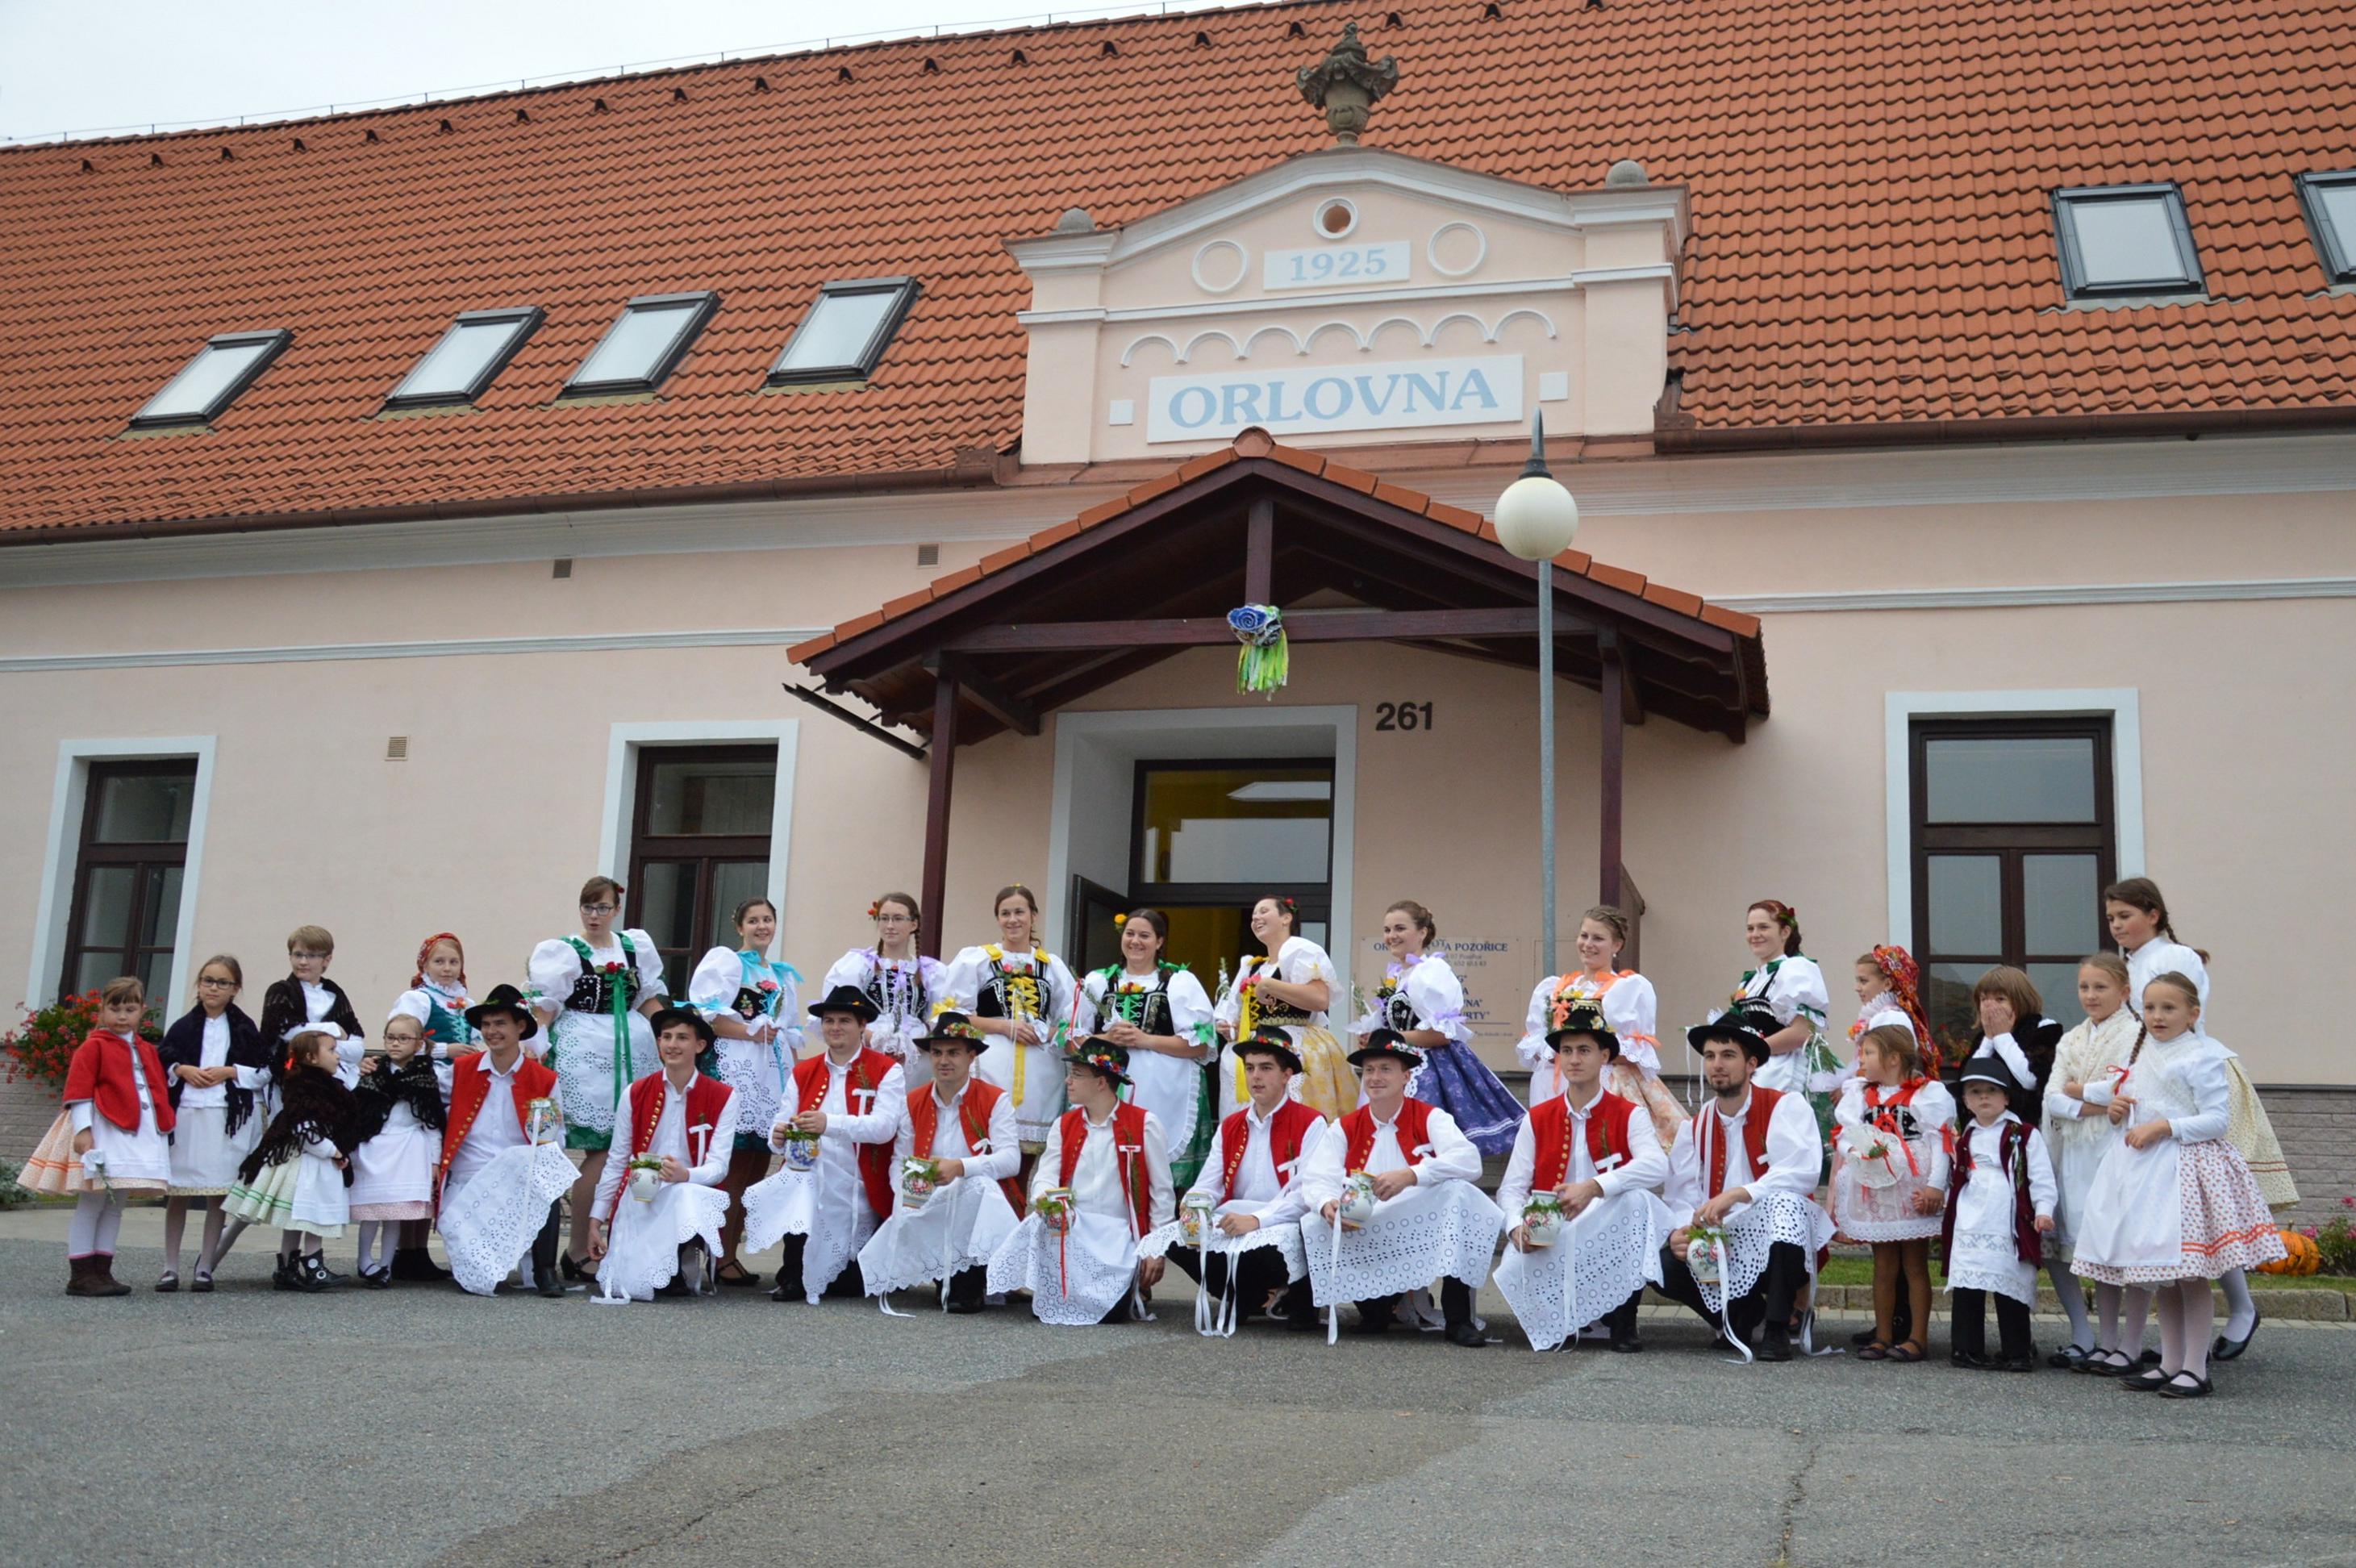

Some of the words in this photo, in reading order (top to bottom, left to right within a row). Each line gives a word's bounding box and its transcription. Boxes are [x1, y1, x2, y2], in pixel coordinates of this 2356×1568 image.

[1291, 248, 1386, 281] 1925
[1168, 368, 1499, 429] ORLOVNA
[1375, 702, 1433, 731] 261
[1455, 940, 1508, 952] POZOŘICE
